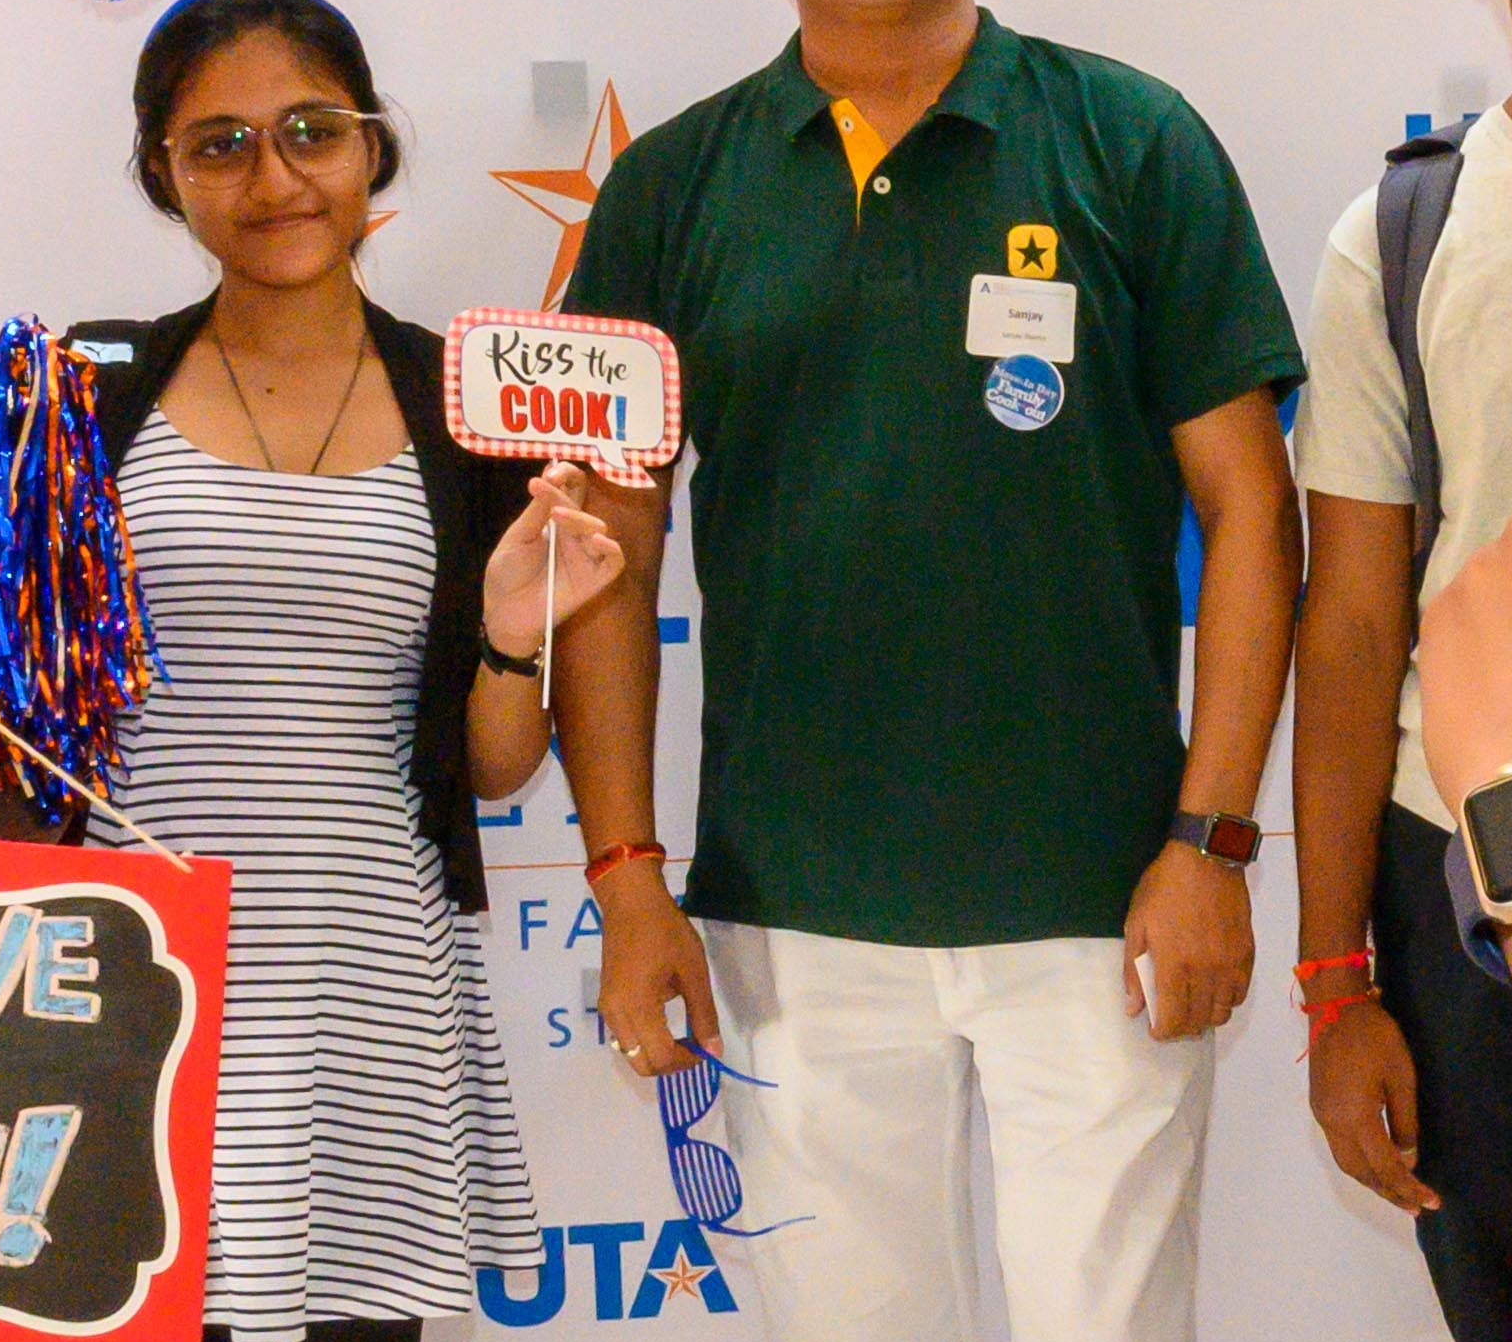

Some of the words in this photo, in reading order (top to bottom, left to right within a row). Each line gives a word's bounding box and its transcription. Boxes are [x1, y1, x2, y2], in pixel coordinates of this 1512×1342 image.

[1008, 308, 1044, 322] Sanjay
[485, 330, 575, 385] Kiss
[580, 346, 631, 384] the
[500, 383, 627, 442] COOK!
[476, 1218, 739, 1328] UTA
